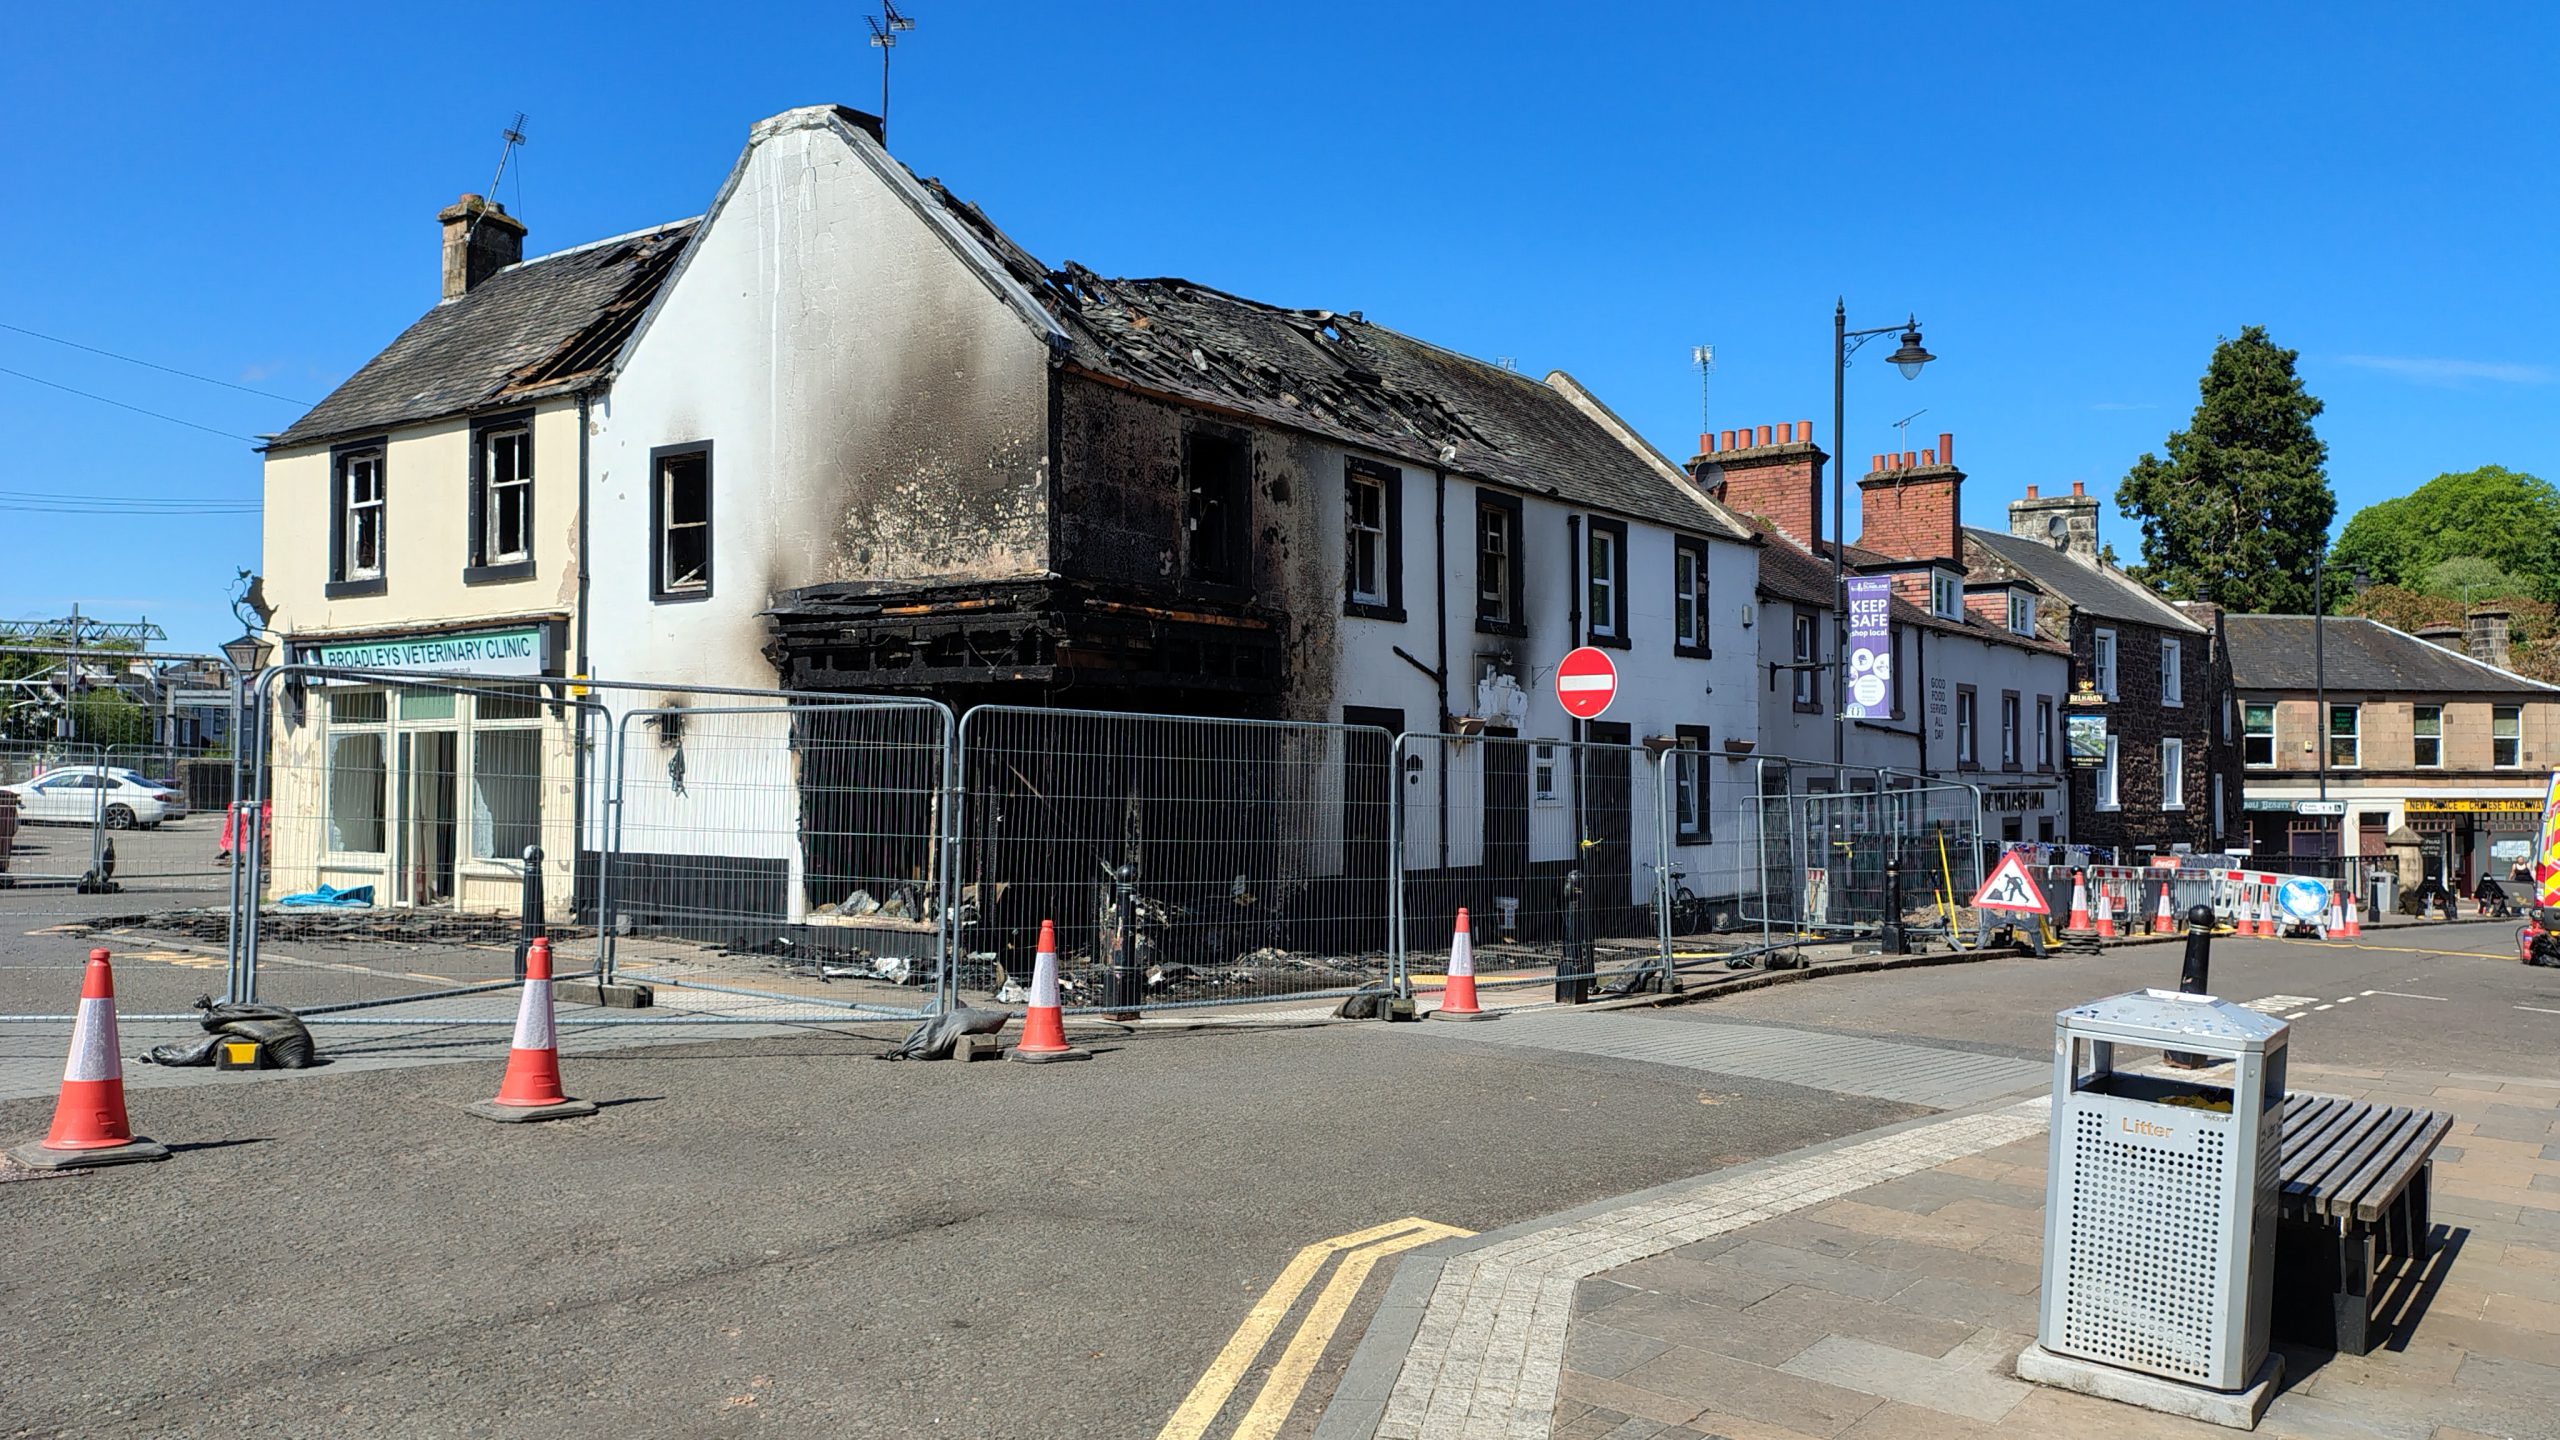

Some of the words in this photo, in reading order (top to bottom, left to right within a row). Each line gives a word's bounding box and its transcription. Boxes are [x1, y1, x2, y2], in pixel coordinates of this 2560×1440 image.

[1851, 599, 1888, 613] KEEP
[1851, 613, 1888, 628] SAFE
[1851, 629, 1869, 638] shop
[1869, 628, 1888, 637] local
[328, 646, 401, 668] BROADLEYS
[401, 639, 482, 665] VETERINARY
[486, 636, 531, 660] CLINIC
[1930, 677, 1947, 690] GOOD
[1931, 690, 1946, 702] FOOD
[2069, 694, 2103, 703] BELHAVEN
[1930, 703, 1948, 716] SERVED
[2409, 800, 2427, 810] NEW
[2429, 800, 2458, 810] PAACE
[2502, 800, 2546, 810] TAKEWAY
[2121, 1117, 2175, 1139] Litter
